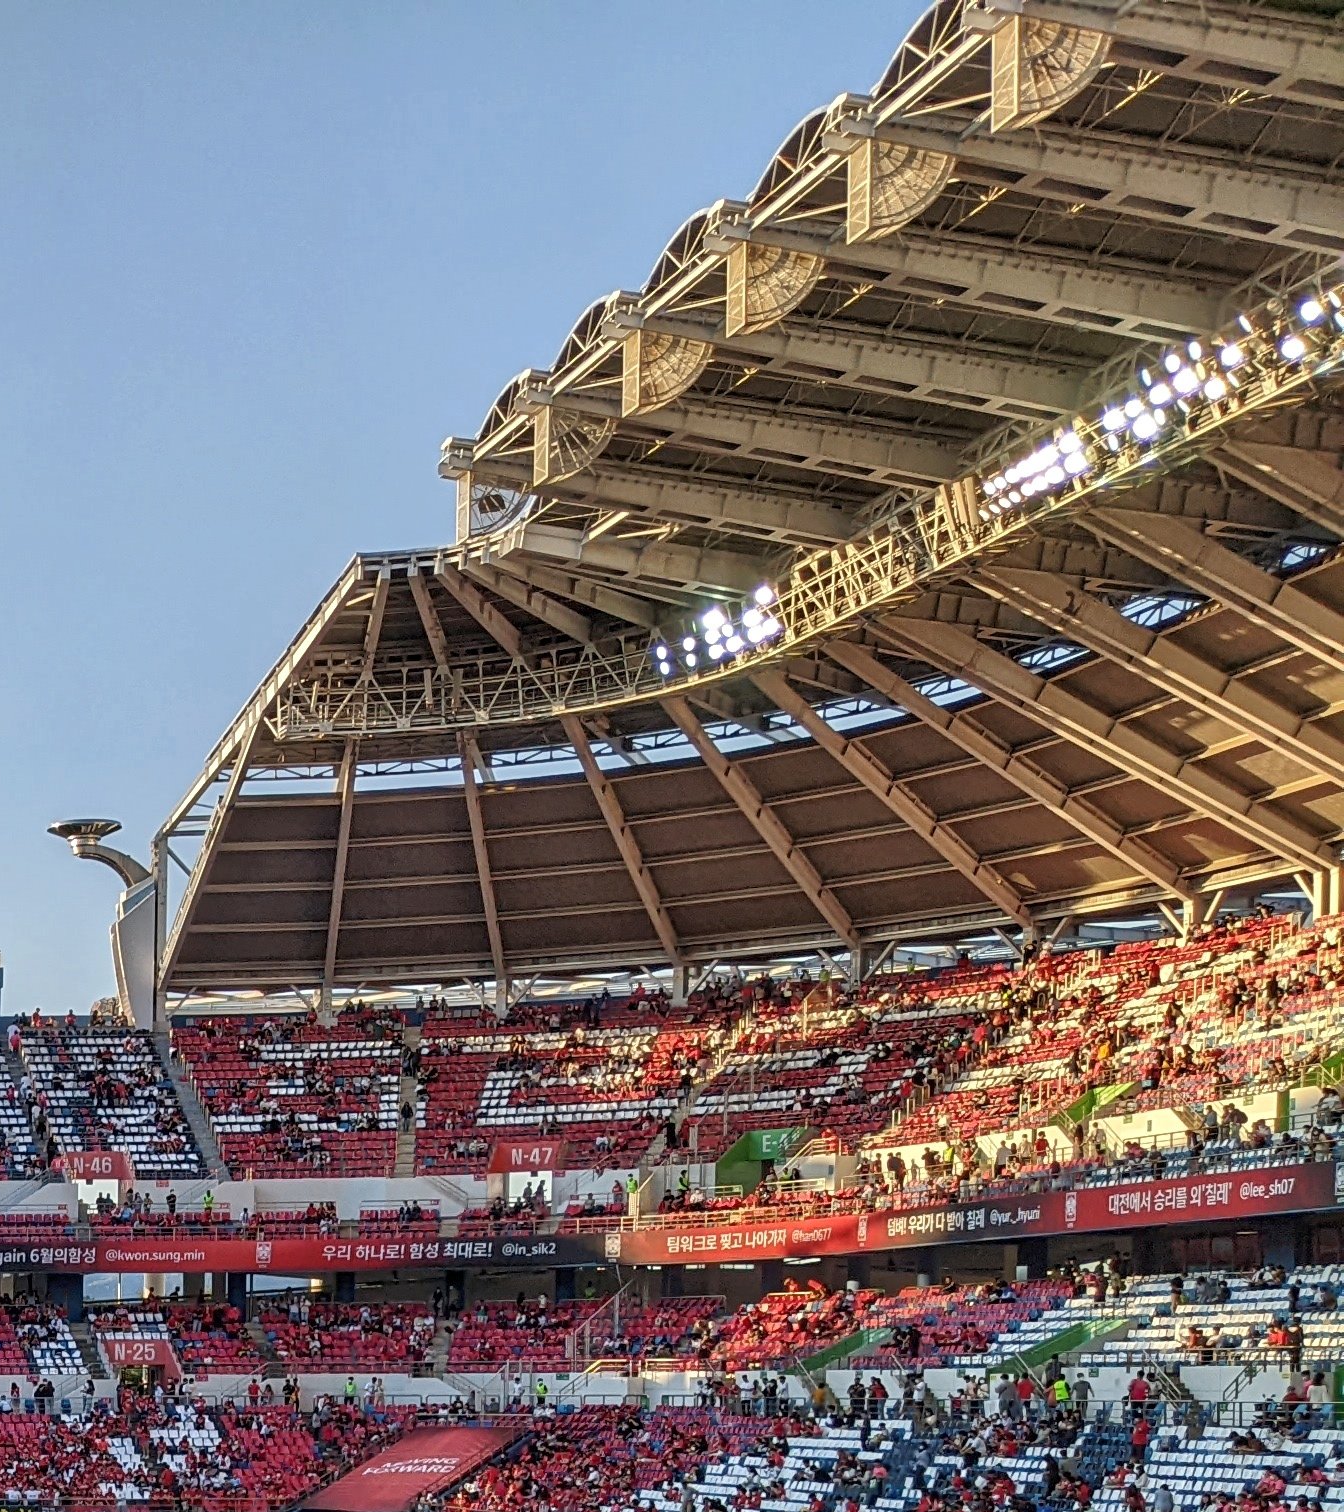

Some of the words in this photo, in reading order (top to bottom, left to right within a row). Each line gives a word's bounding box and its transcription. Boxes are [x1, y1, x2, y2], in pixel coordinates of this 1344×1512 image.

[73, 1156, 112, 1173] N-46
[511, 1147, 553, 1166] N-47
[1108, 1190, 1151, 1216] 대전에서
[1153, 1187, 1187, 1211] 승리를
[1239, 1177, 1295, 1200] @lee_sh07
[908, 1213, 934, 1233] 우리가
[966, 1207, 985, 1230] 칠레
[667, 1235, 717, 1253] 팀워크로
[746, 1228, 787, 1247] 나아가자
[105, 1249, 205, 1263] @kwon.sung.min
[322, 1245, 351, 1261] 우리
[356, 1244, 405, 1260] 하나로!
[410, 1243, 439, 1260] 함성
[443, 1242, 492, 1259] 최대로!
[502, 1242, 557, 1257] @in_sik2
[114, 1343, 156, 1361] N-25
